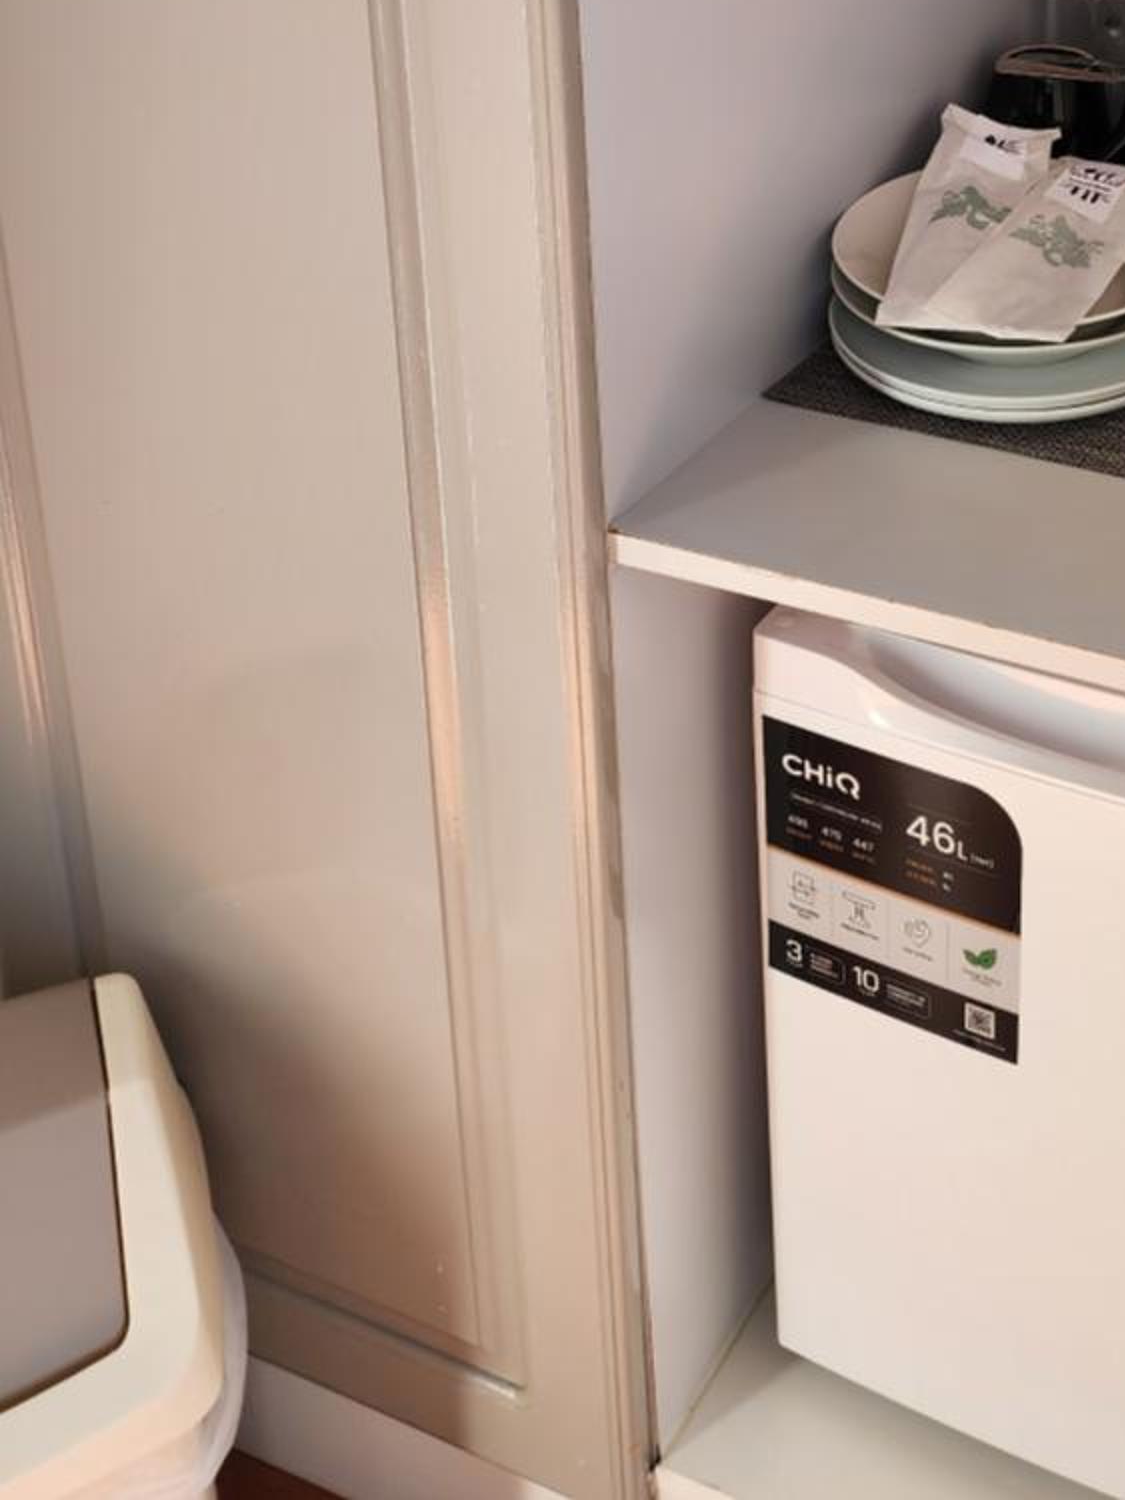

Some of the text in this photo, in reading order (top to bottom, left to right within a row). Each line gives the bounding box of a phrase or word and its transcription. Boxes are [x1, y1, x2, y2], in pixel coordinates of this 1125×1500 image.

[781, 753, 861, 801] CHiQ
[785, 939, 803, 963] 3
[852, 965, 880, 993] 10
